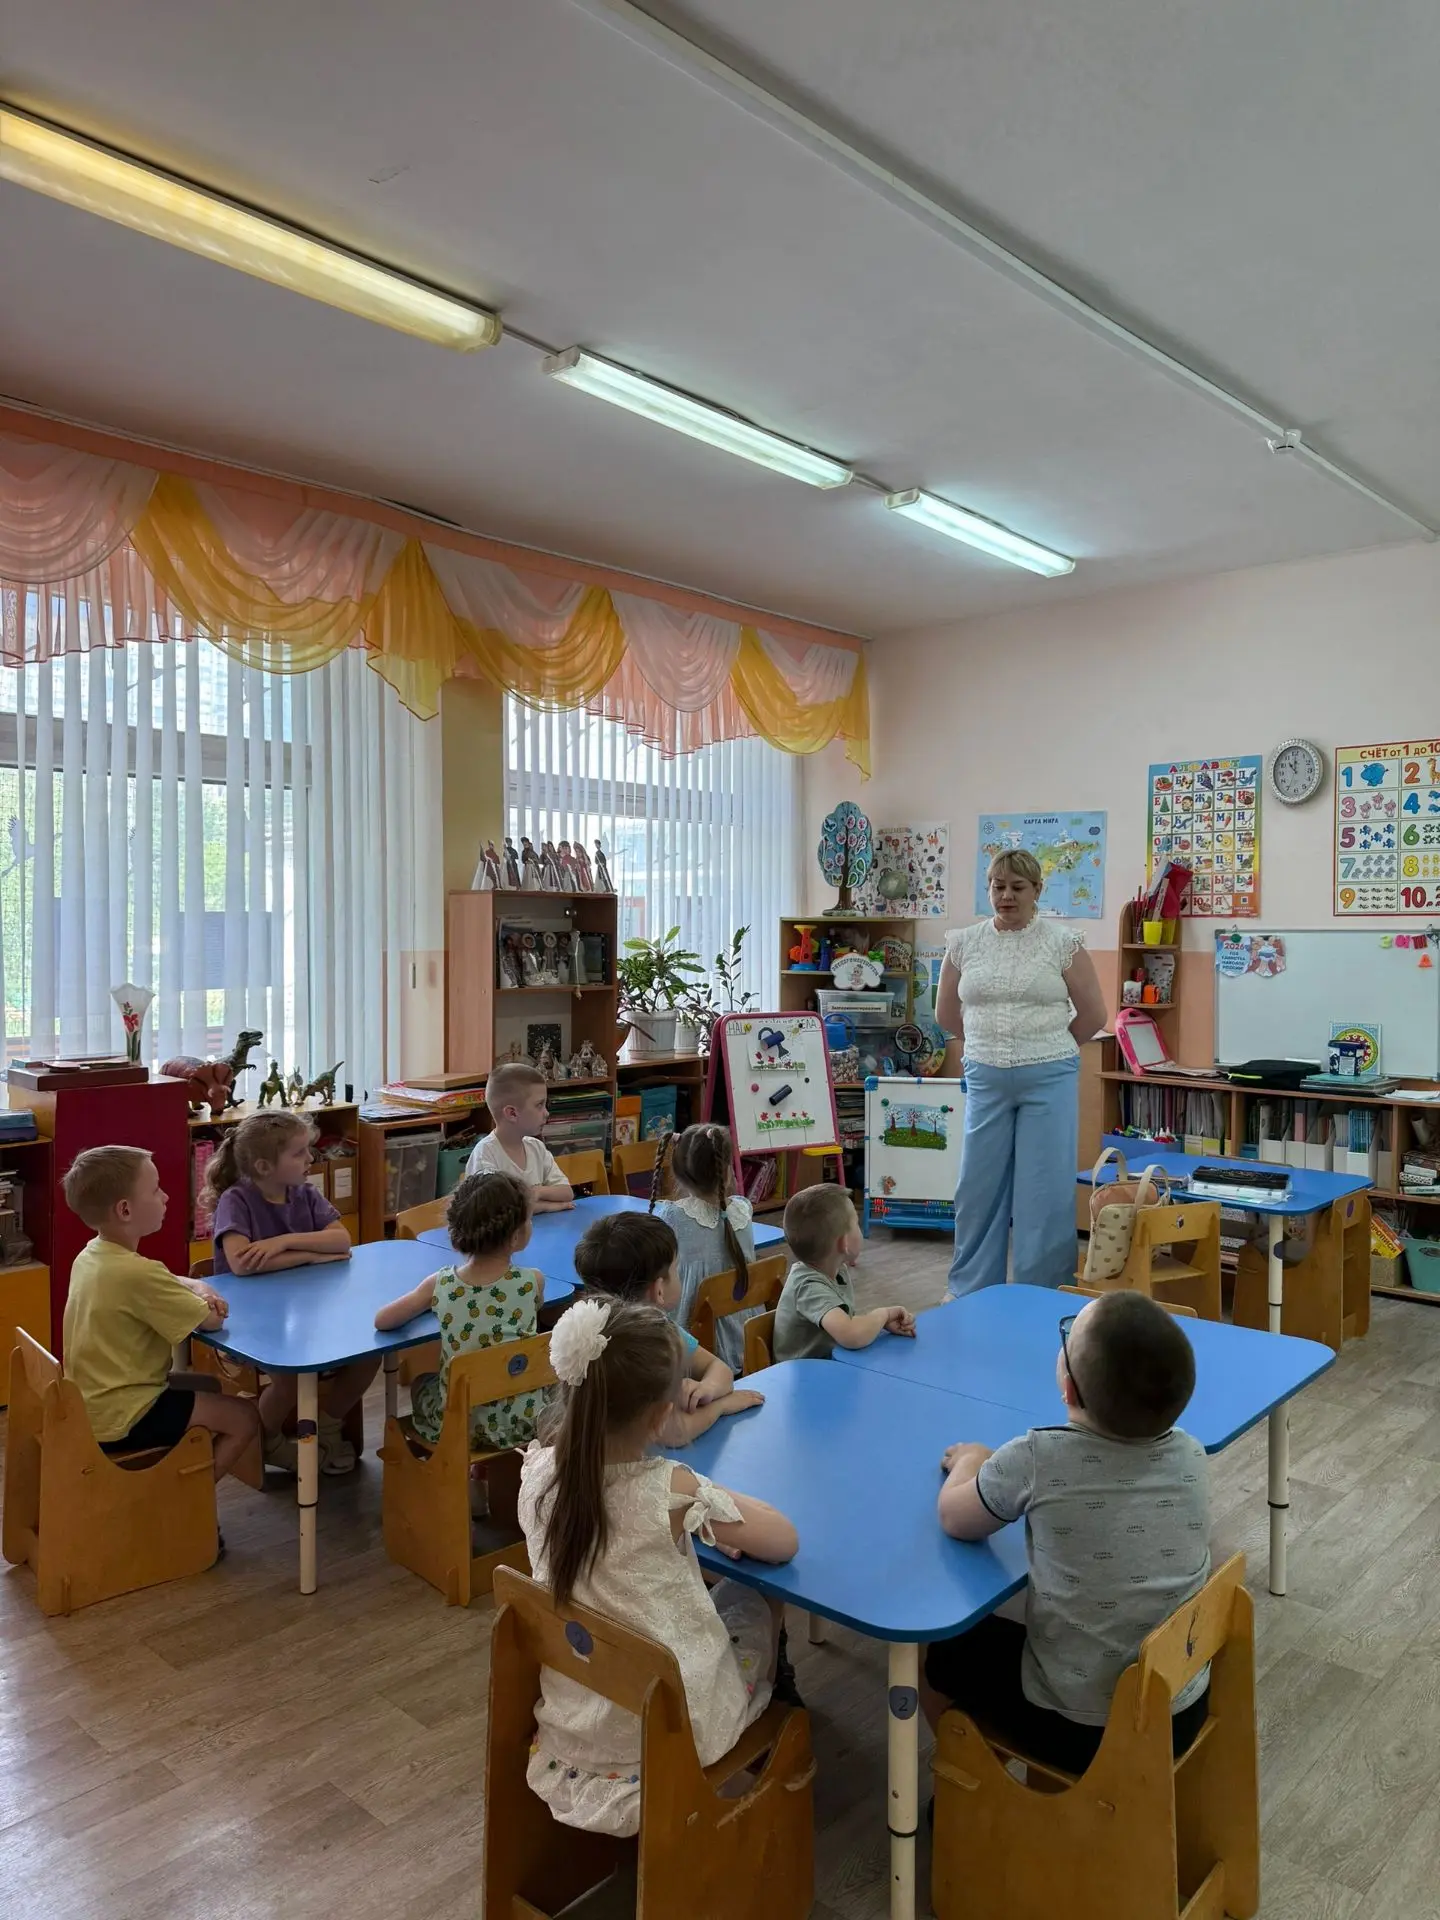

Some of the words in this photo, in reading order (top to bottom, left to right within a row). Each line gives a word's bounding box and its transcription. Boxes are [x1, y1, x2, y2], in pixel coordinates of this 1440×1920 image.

[1360, 748, 1388, 759] СЧЁТ
[1403, 745, 1409, 755] 1
[1414, 748, 1426, 756] до
[1169, 760, 1240, 774] АЛФАВИТ
[1342, 766, 1353, 787] 1
[1404, 762, 1420, 784] 2
[1176, 776, 1182, 784] Б
[1195, 794, 1205, 802] Ж
[1238, 791, 1245, 799] И
[1341, 796, 1356, 818] 3
[1403, 793, 1420, 814] 4
[1217, 813, 1224, 821] М
[1238, 812, 1244, 820] Н
[1216, 834, 1223, 842] С
[1237, 833, 1244, 842] Т
[1340, 827, 1355, 848] 5
[1403, 824, 1420, 846] 6
[1154, 838, 1160, 846] О
[1175, 836, 1182, 844] П
[1196, 836, 1202, 844] Р
[1174, 856, 1182, 864] Ф
[1196, 856, 1202, 864] Х
[1216, 856, 1223, 864] Ц
[1237, 854, 1243, 862] Ч
[1340, 857, 1356, 878] 7
[1403, 855, 1419, 877] 8
[1214, 876, 1224, 884] Ы
[1194, 897, 1204, 906] Ю
[1216, 896, 1222, 905] Я
[1340, 888, 1356, 909] 9
[1400, 886, 1426, 908] 10
[899, 1696, 908, 1711] 2
